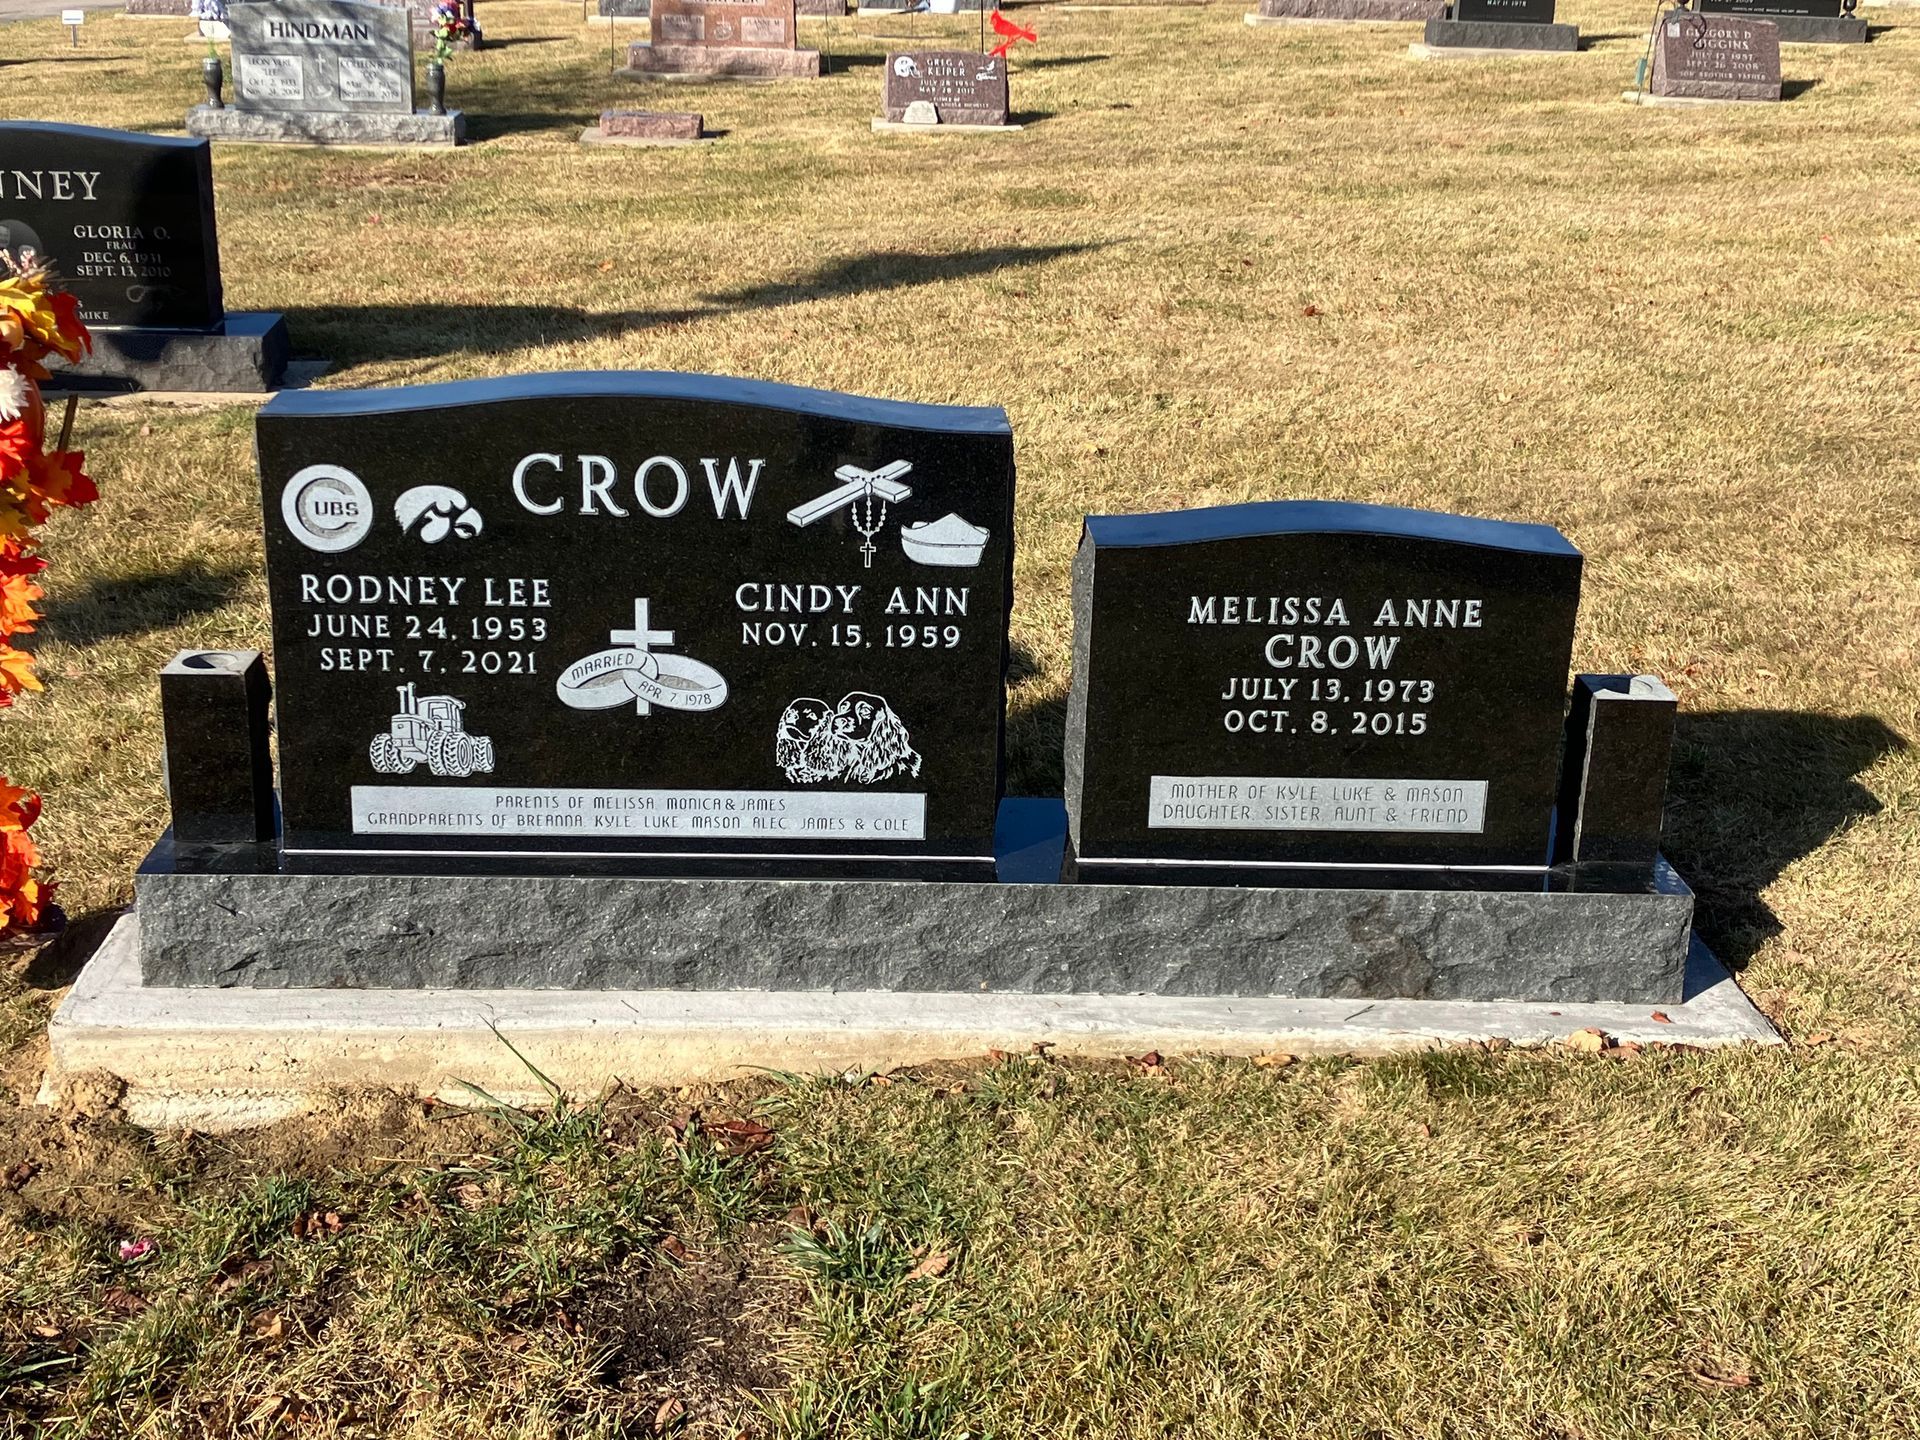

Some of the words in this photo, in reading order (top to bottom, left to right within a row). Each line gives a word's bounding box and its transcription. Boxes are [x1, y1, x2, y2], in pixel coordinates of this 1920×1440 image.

[269, 22, 369, 40] HINDMAN
[1690, 51, 1713, 59] JULY
[0, 170, 101, 200] NEY
[73, 225, 143, 239] GLORIA
[153, 227, 171, 240] O.
[106, 241, 137, 250] FRAU
[83, 252, 116, 263] DEC.
[119, 252, 131, 265] 6,
[76, 265, 117, 276] SEPT.
[79, 311, 109, 320] MIKE
[512, 453, 767, 520] CROW
[301, 574, 466, 605] RODNEY
[484, 578, 551, 607] LEE
[735, 583, 861, 613] CINDY
[885, 586, 969, 616] ANN
[1187, 596, 1350, 626] MELISSA
[1374, 599, 1482, 628] ANNE
[307, 614, 391, 638] JUNE
[406, 616, 458, 640] 24,
[472, 617, 548, 641] 1953
[742, 623, 818, 647] NOV.
[831, 625, 872, 648] 15,
[884, 625, 961, 648] 1959
[320, 648, 406, 673] SEPT.
[419, 650, 447, 674] 7,
[461, 651, 538, 674] 2021
[1264, 634, 1400, 669] CROW
[571, 652, 635, 681] MARRIED
[685, 693, 713, 706] 1978
[1222, 677, 1298, 700] JULY
[1311, 678, 1350, 702] 13,
[1364, 679, 1435, 703] 1973
[1224, 709, 1297, 734] OCT.
[1311, 710, 1338, 735] 8,
[1352, 711, 1427, 735] 2015
[496, 795, 559, 809] PARENTS
[568, 796, 584, 809] OF
[667, 797, 721, 811] MONICA
[725, 798, 736, 811] &
[740, 799, 786, 812] JAMES
[1170, 783, 1238, 799] MOTHER
[1248, 785, 1268, 799] OF
[1333, 786, 1374, 802] LUKE
[1384, 786, 1397, 802] &
[1406, 786, 1463, 803] MASON
[367, 812, 483, 826] GRANDPARENTS
[491, 814, 507, 826] OF
[692, 816, 741, 829] MASON
[800, 817, 845, 831] JAMES
[855, 818, 866, 831] &
[873, 818, 909, 831] COLE
[1335, 806, 1376, 823] AUNT
[1386, 807, 1399, 824] &
[1411, 808, 1468, 824] FRIEND
